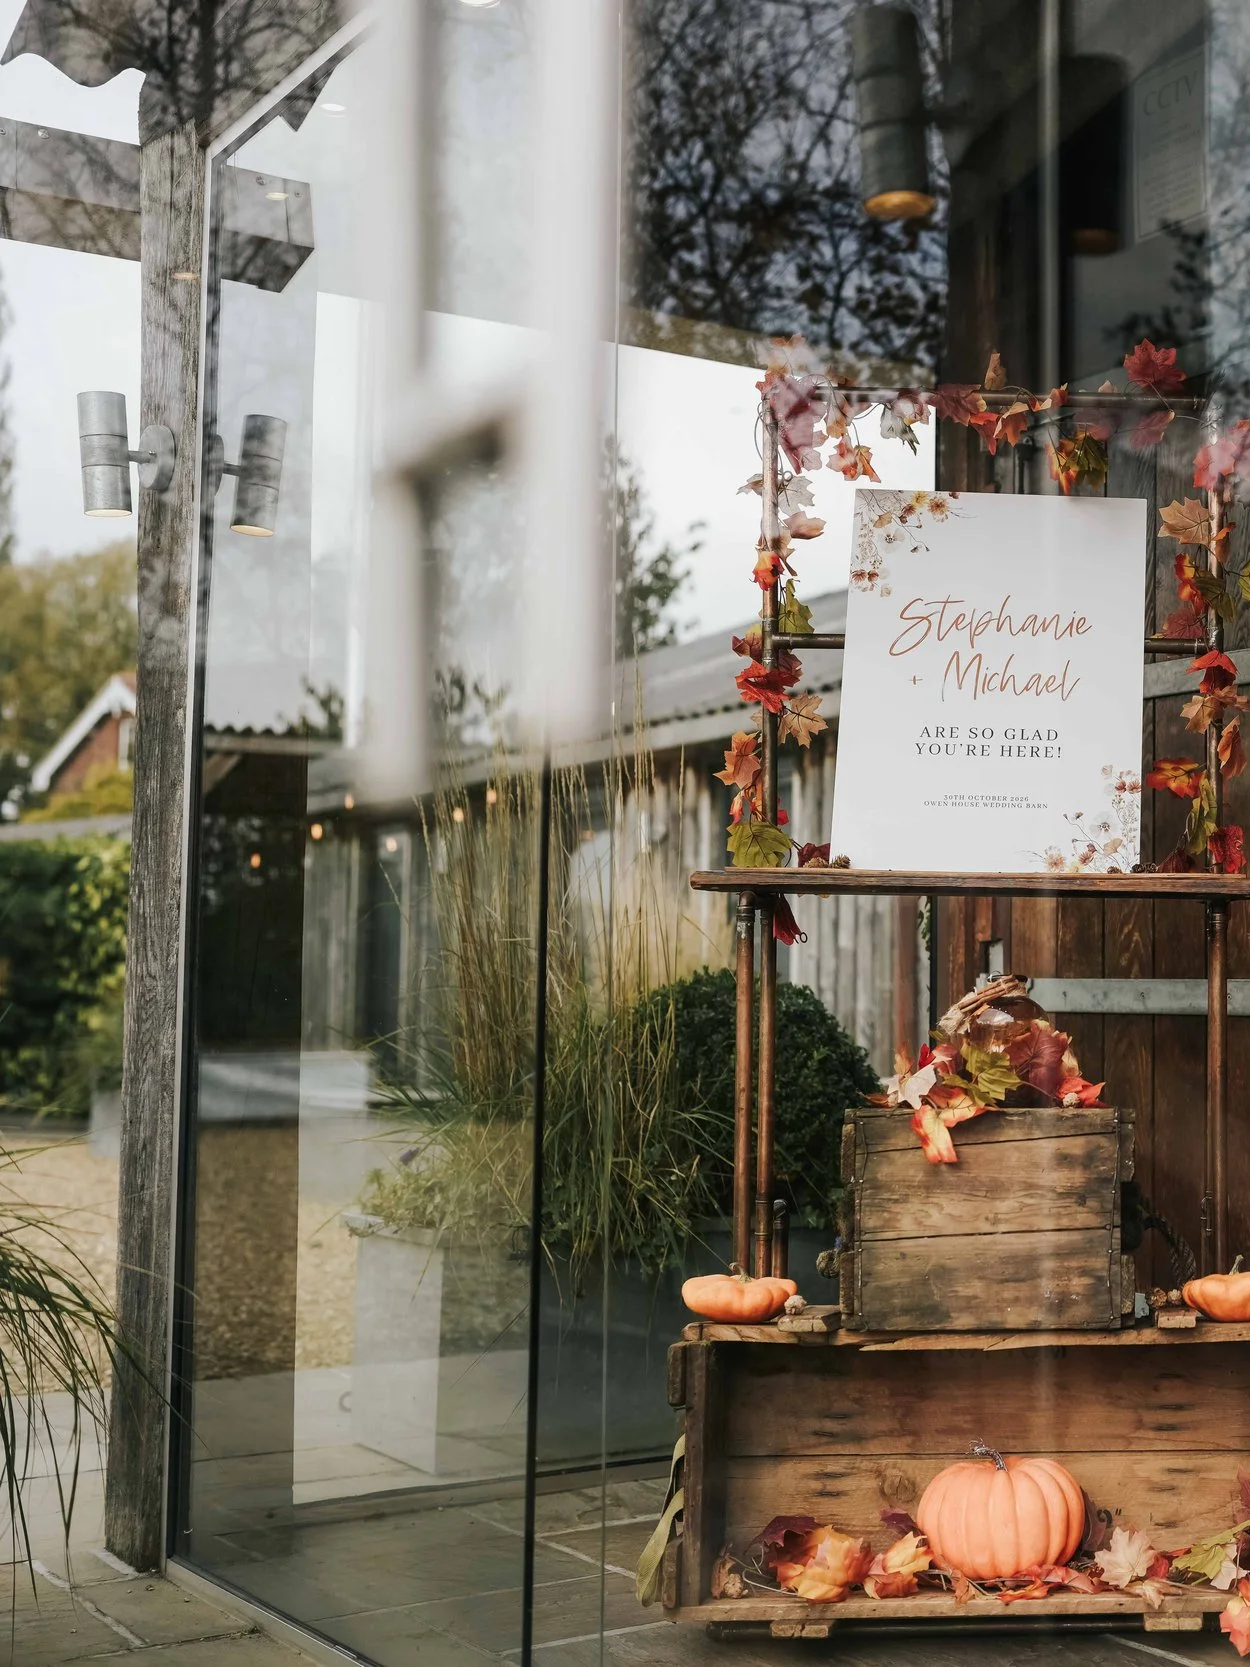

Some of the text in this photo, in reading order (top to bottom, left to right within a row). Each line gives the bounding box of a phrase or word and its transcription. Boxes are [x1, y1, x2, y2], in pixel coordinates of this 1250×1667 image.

[1143, 69, 1199, 116] CCTV
[889, 595, 1095, 656] Stephanie
[941, 651, 1081, 702] Michael
[915, 742, 1062, 758] YOU'RE HERE!
[919, 726, 1059, 741] ARE SO GLAD
